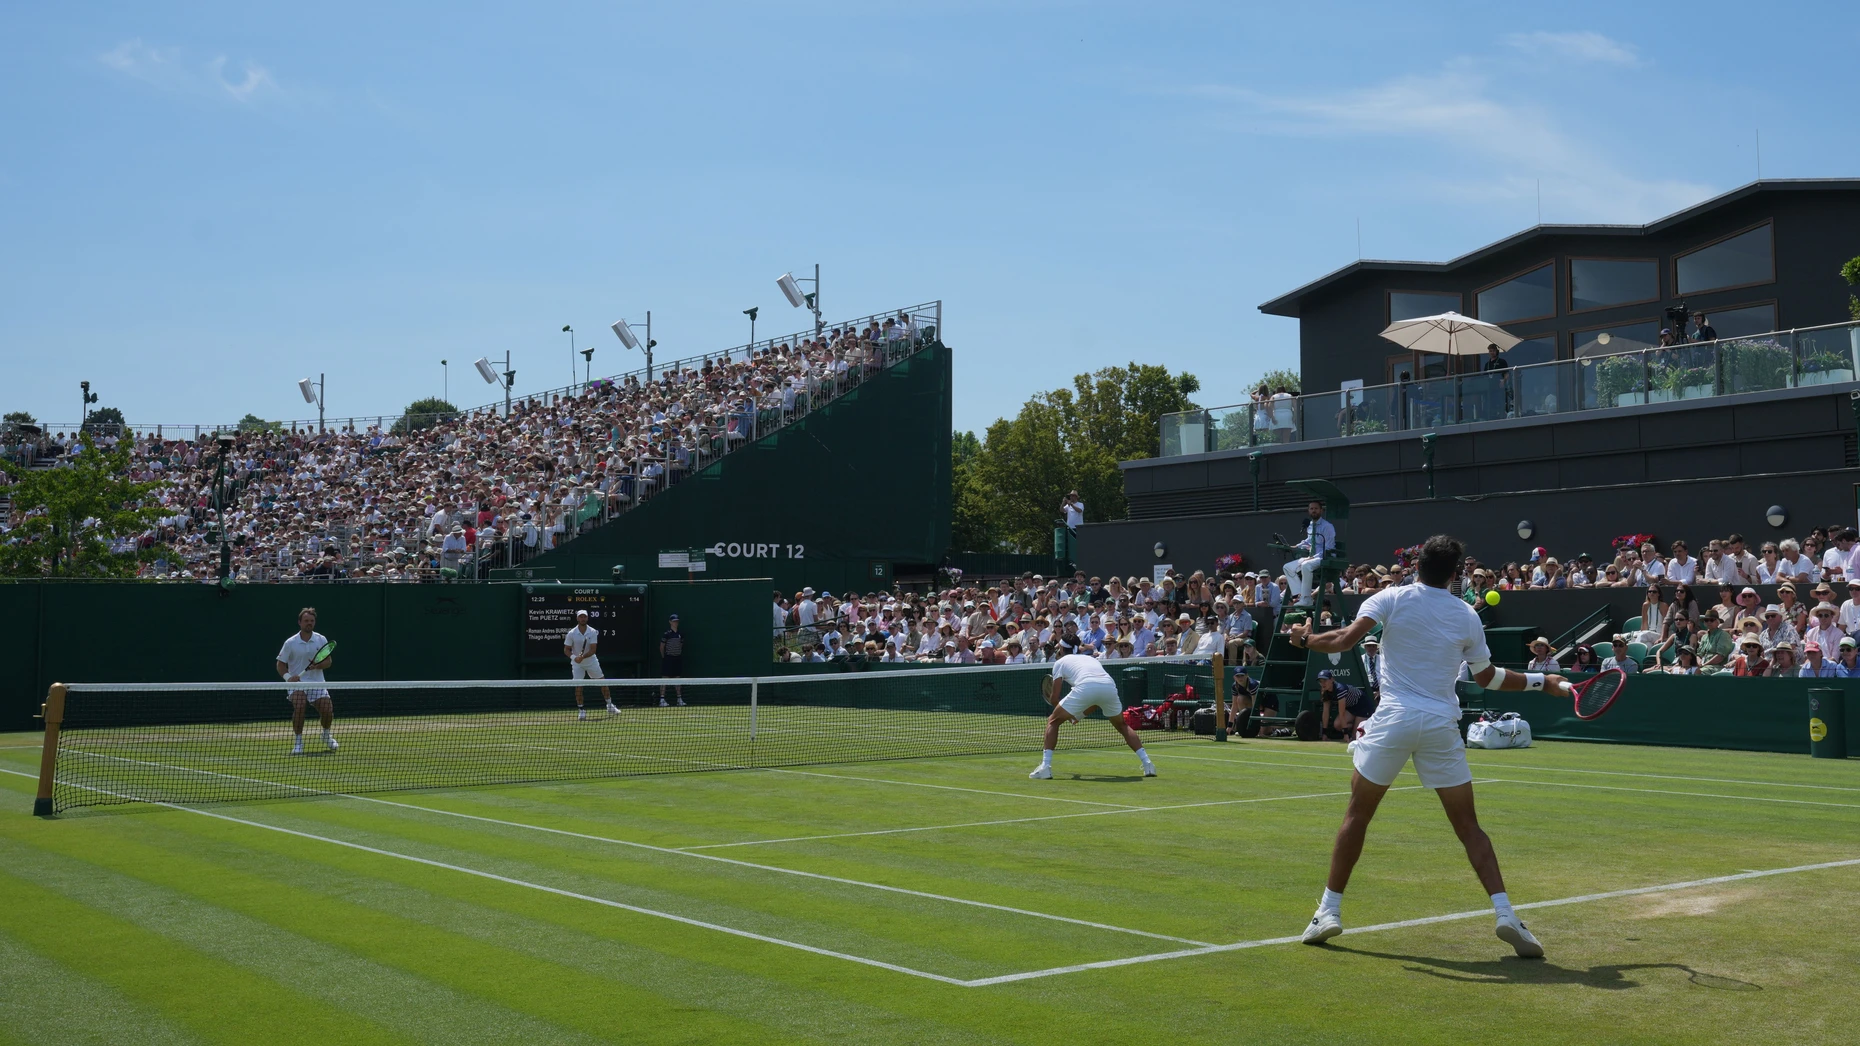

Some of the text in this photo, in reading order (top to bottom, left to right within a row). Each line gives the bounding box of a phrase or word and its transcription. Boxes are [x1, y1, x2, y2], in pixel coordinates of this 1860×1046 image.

[714, 542, 805, 559] COURT 12
[875, 568, 883, 576] 12
